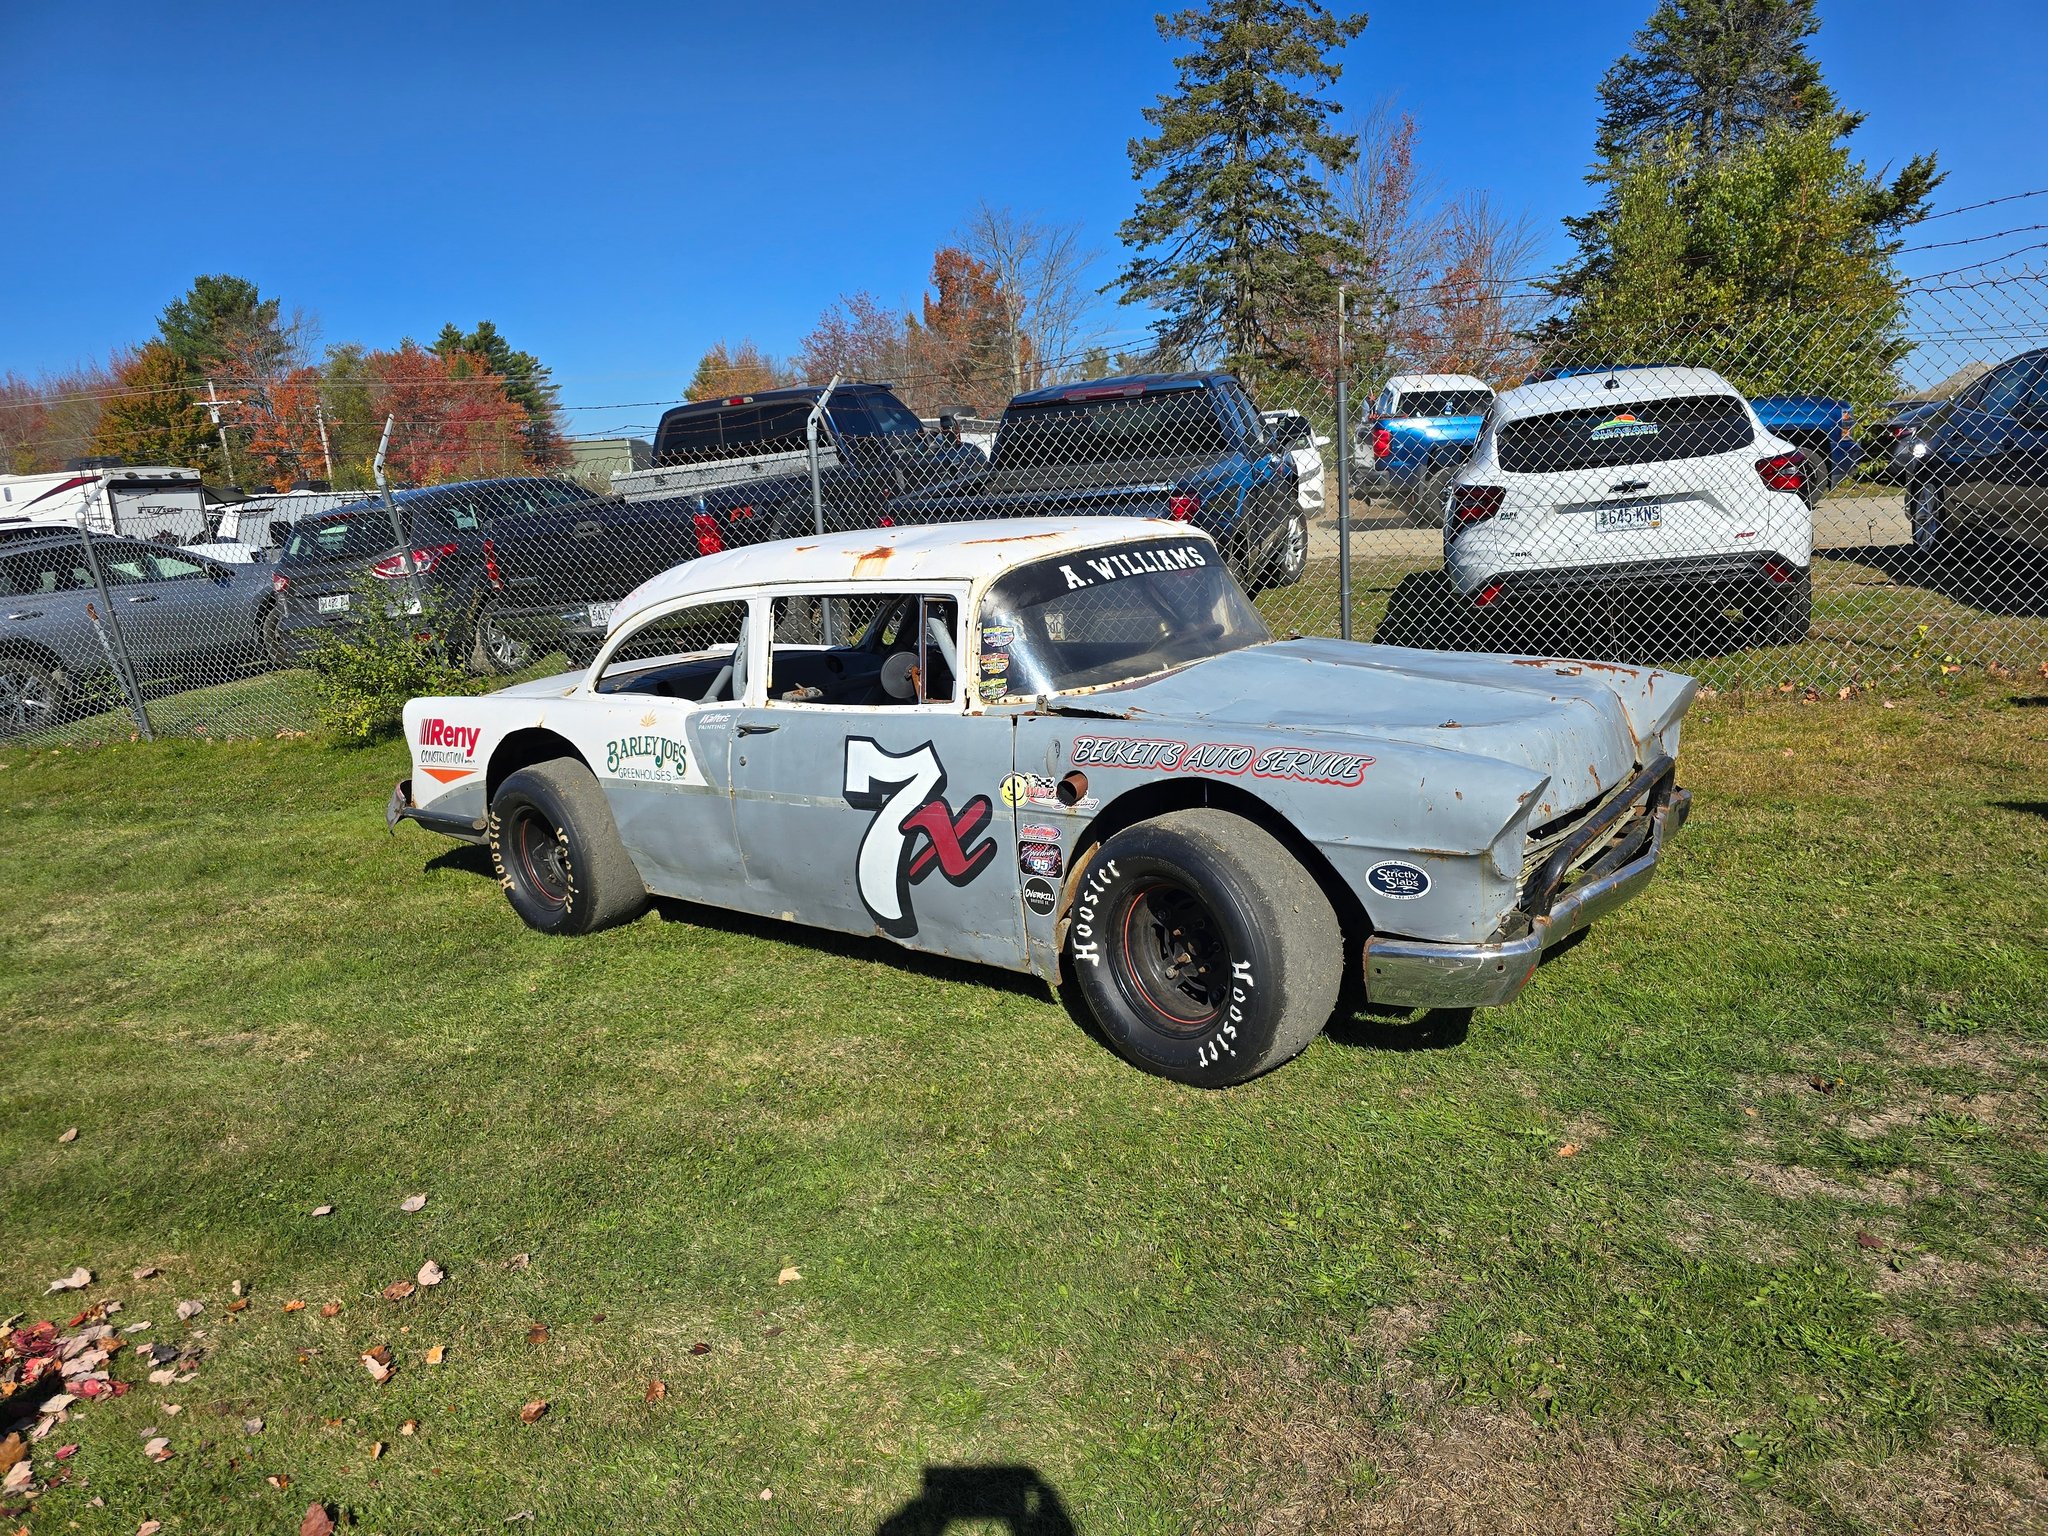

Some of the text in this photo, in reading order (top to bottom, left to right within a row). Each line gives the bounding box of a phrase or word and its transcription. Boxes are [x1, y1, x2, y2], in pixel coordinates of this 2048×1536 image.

[1058, 546, 1207, 590] A. WILLIAMS
[420, 750, 465, 764] CONSTRUCTION
[429, 718, 482, 757] Reny
[607, 736, 687, 776] BARLEY JOE'S
[618, 767, 672, 781] GREENHOUSES
[1073, 737, 1185, 765] BECKETT'S
[1183, 744, 1254, 770] AUTO
[1254, 747, 1373, 778] SERVICE
[489, 811, 516, 891] Hoosier
[556, 827, 579, 914] Hoosier
[1033, 859, 1049, 871] 95
[1376, 868, 1419, 881] Strictly
[1385, 877, 1420, 889] Slabs
[1025, 888, 1055, 902] OVERKILL
[1072, 858, 1121, 967] Hoosier
[1198, 959, 1254, 1068] Hoosier
